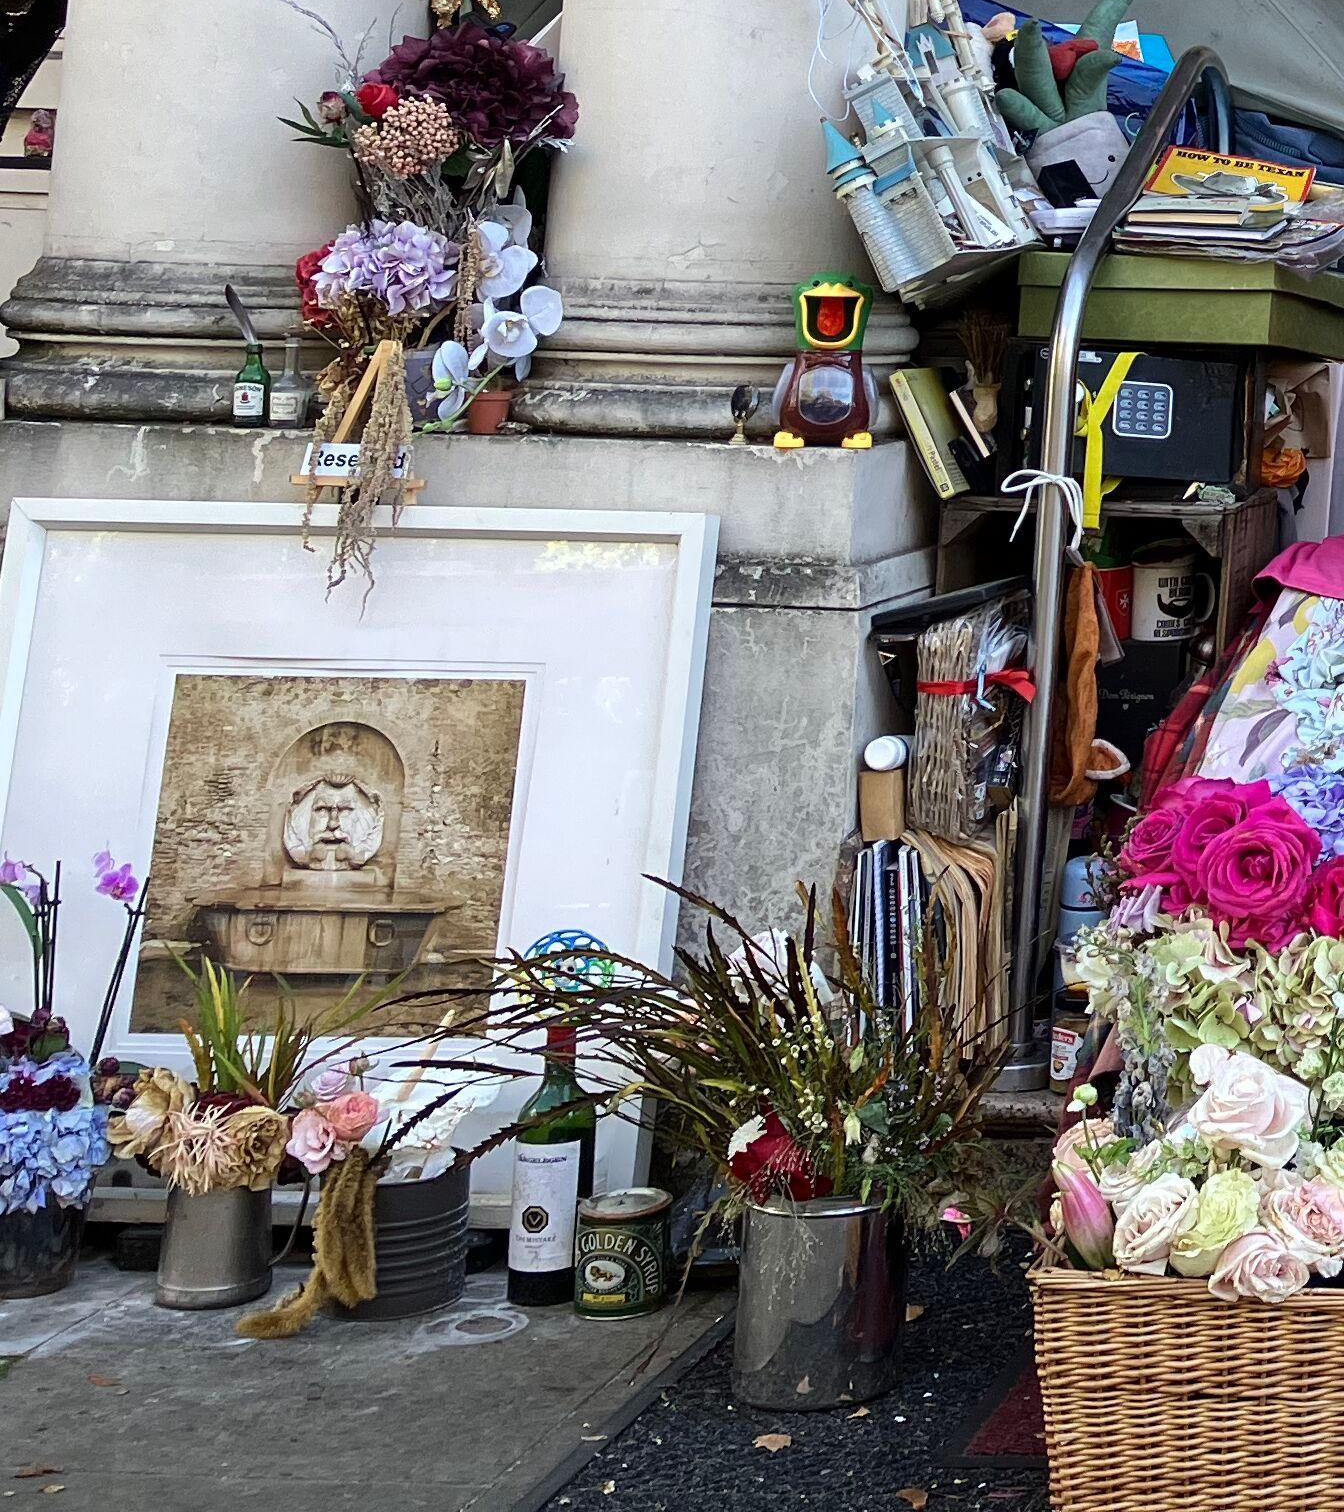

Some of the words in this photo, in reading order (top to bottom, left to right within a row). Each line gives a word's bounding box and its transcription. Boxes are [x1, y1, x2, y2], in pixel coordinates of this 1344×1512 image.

[1176, 150, 1211, 162] HOW
[1213, 156, 1231, 166] TO
[1233, 160, 1254, 169] BE
[1258, 163, 1305, 178] TEXAN
[581, 1233, 638, 1256] GOLDEN
[635, 1246, 659, 1294] SYRUP
